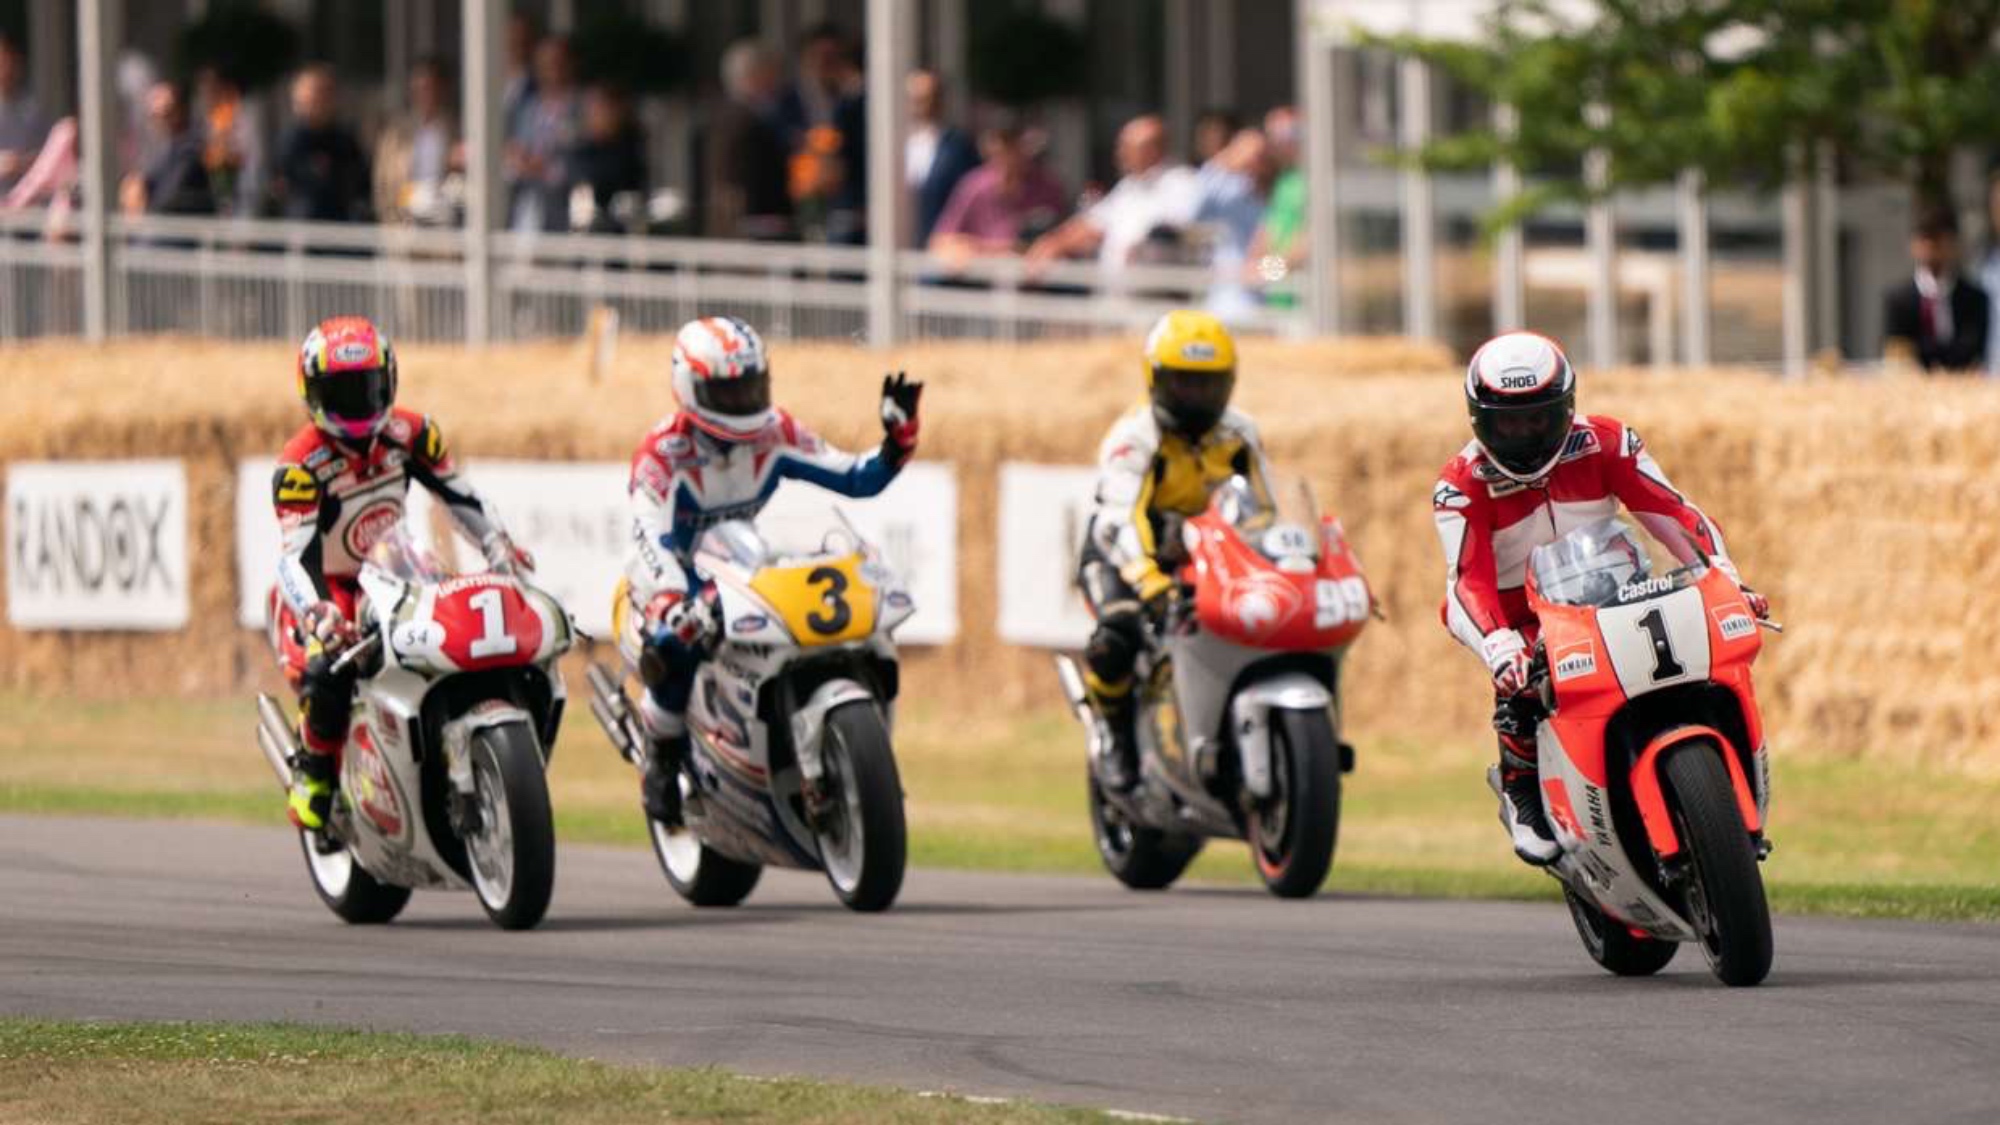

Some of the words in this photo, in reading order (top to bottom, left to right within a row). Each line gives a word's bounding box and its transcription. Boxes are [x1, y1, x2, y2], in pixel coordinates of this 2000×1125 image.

[1501, 374, 1538, 389] SHOEI
[14, 494, 177, 593] RANDOX
[806, 566, 852, 636] 3
[1315, 575, 1370, 630] 99
[1618, 575, 1674, 602] Castrol
[405, 629, 428, 646] 54
[469, 588, 518, 659] 1
[1637, 607, 1685, 682] 1
[1556, 656, 1594, 677] YAMAHA
[1586, 784, 1614, 847] YAMAHA
